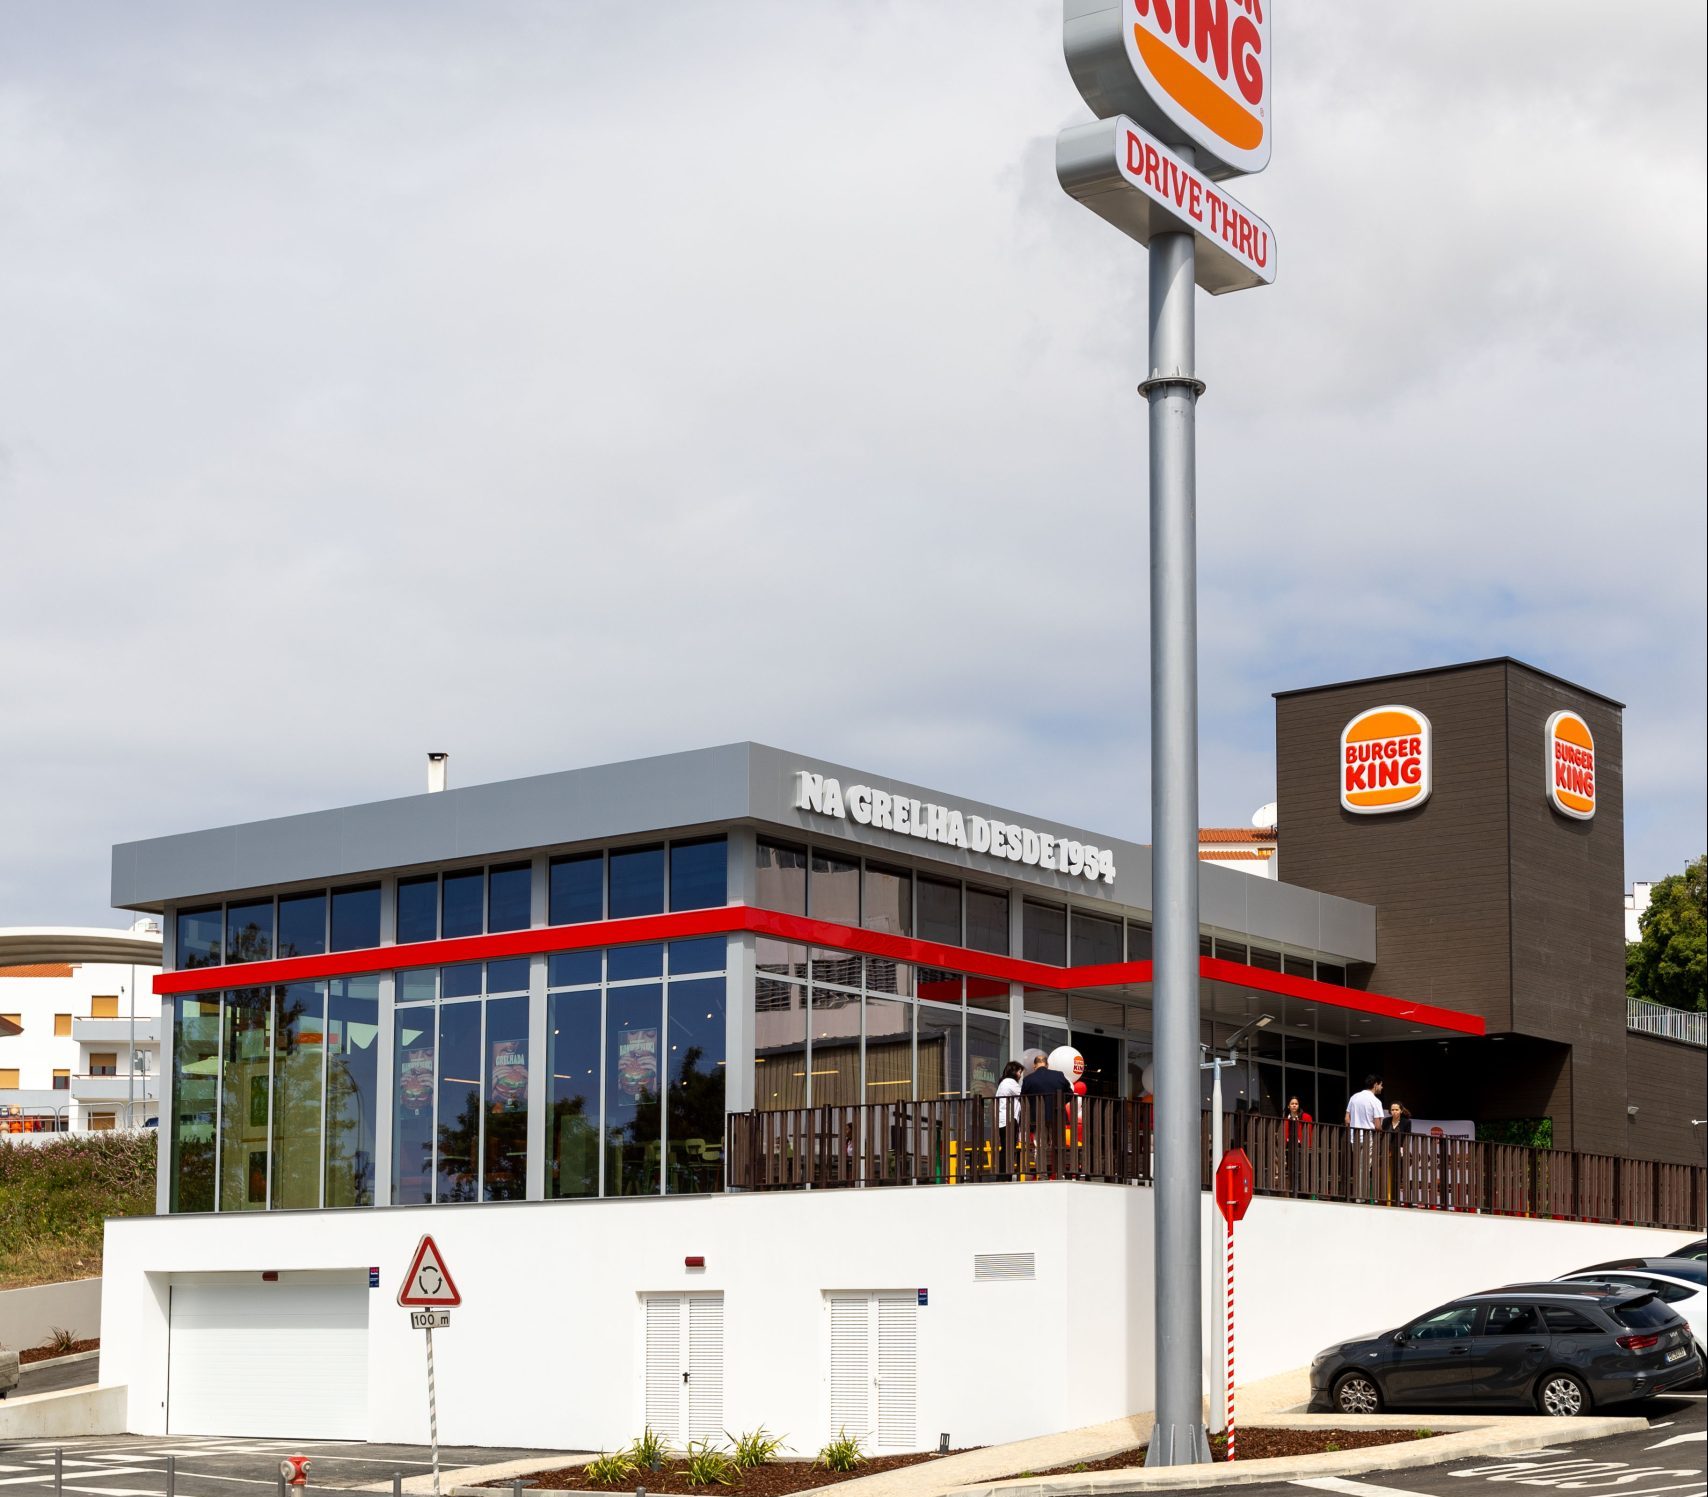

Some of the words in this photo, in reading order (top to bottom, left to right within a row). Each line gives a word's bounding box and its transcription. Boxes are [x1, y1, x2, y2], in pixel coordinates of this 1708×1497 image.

[1134, 0, 1263, 105] ING
[1126, 130, 1203, 223] DRIVE
[1206, 189, 1268, 269] THRU
[1346, 737, 1421, 764] BURGER
[1555, 741, 1593, 771] BURGER
[1346, 757, 1421, 791] KING
[1555, 761, 1594, 798] KING
[796, 770, 846, 818] NA
[846, 785, 968, 849] GRELHA
[967, 815, 1056, 870] DESDE
[1054, 838, 1116, 885] 1954
[415, 1314, 435, 1326] 100
[440, 1316, 449, 1325] m
